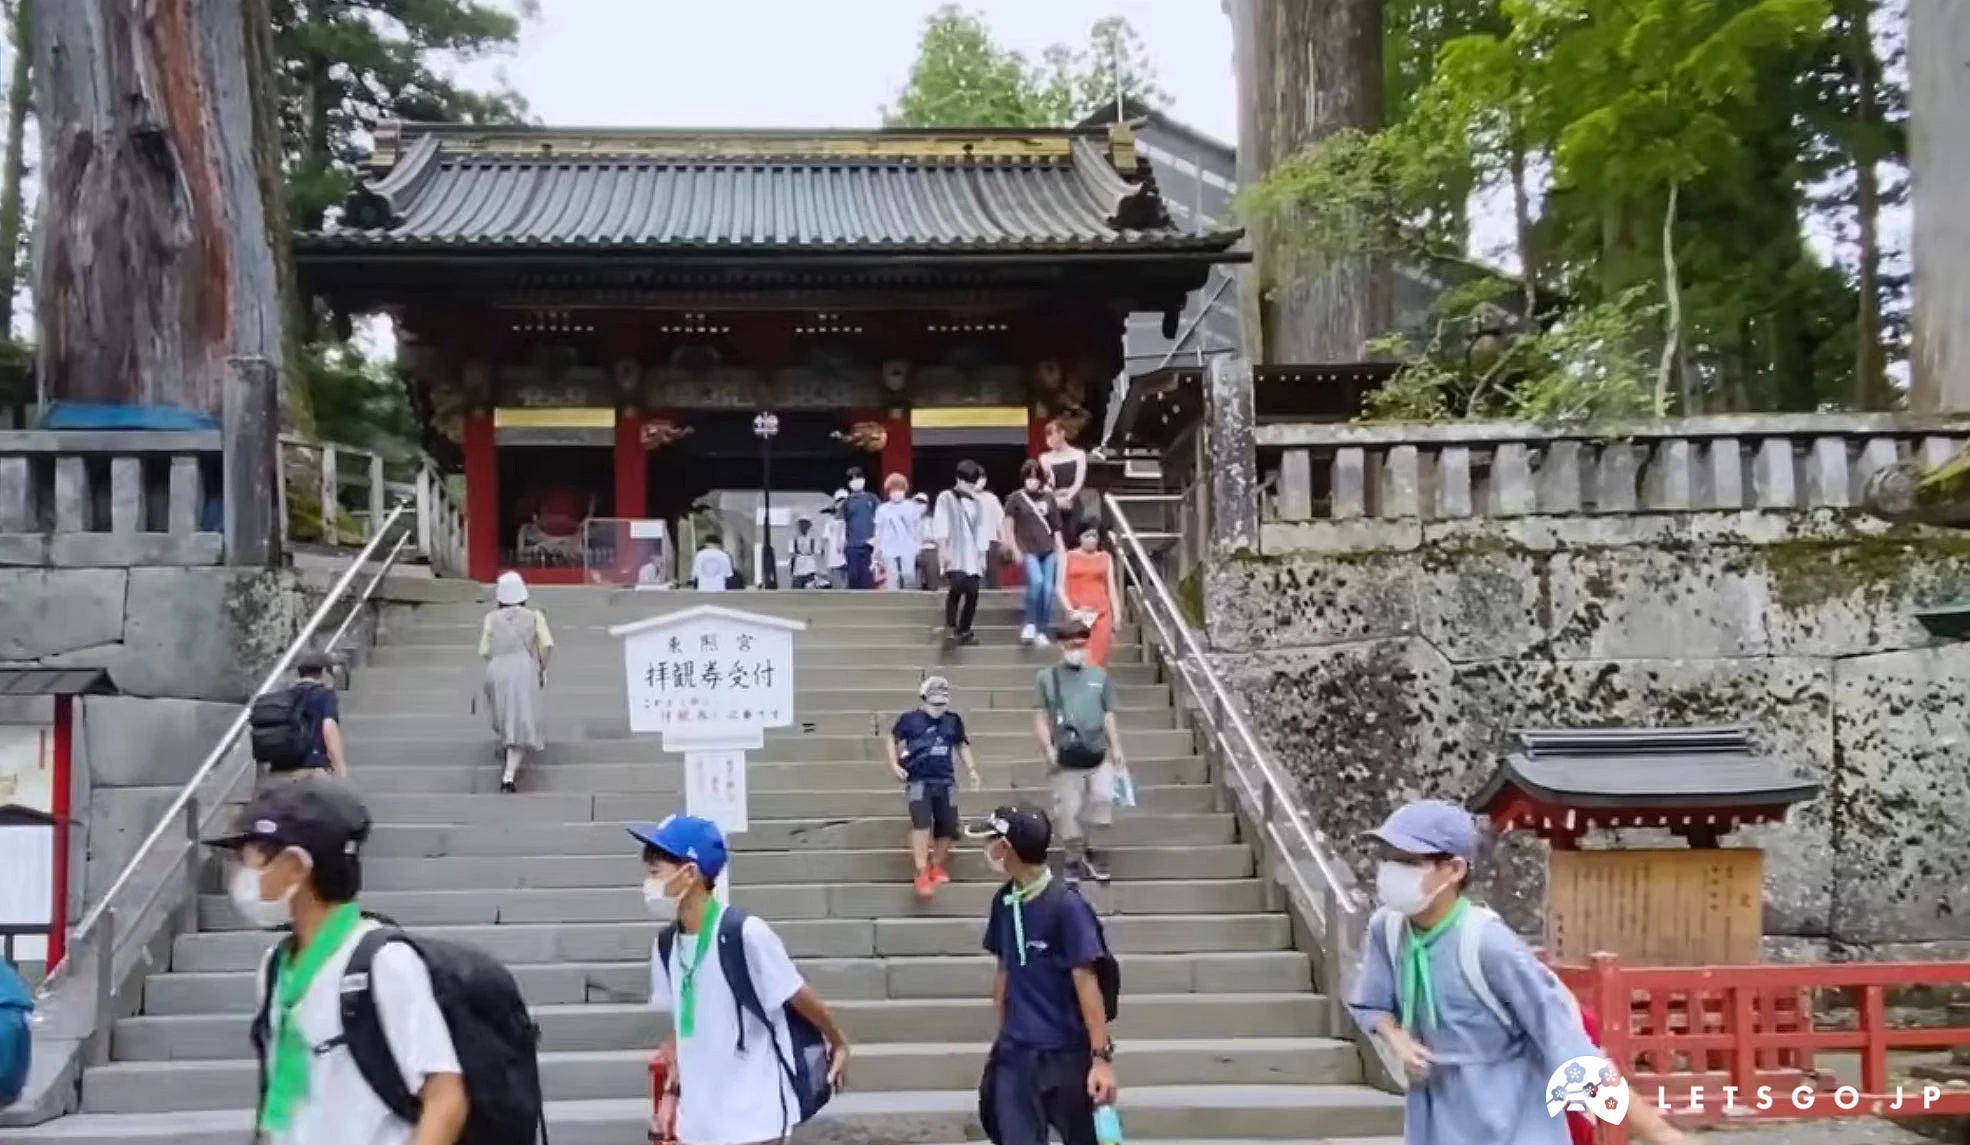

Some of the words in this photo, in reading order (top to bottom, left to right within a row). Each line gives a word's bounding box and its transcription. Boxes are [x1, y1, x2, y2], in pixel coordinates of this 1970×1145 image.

[668, 633, 756, 653] 東照宮
[645, 658, 776, 691] 拝観券受付
